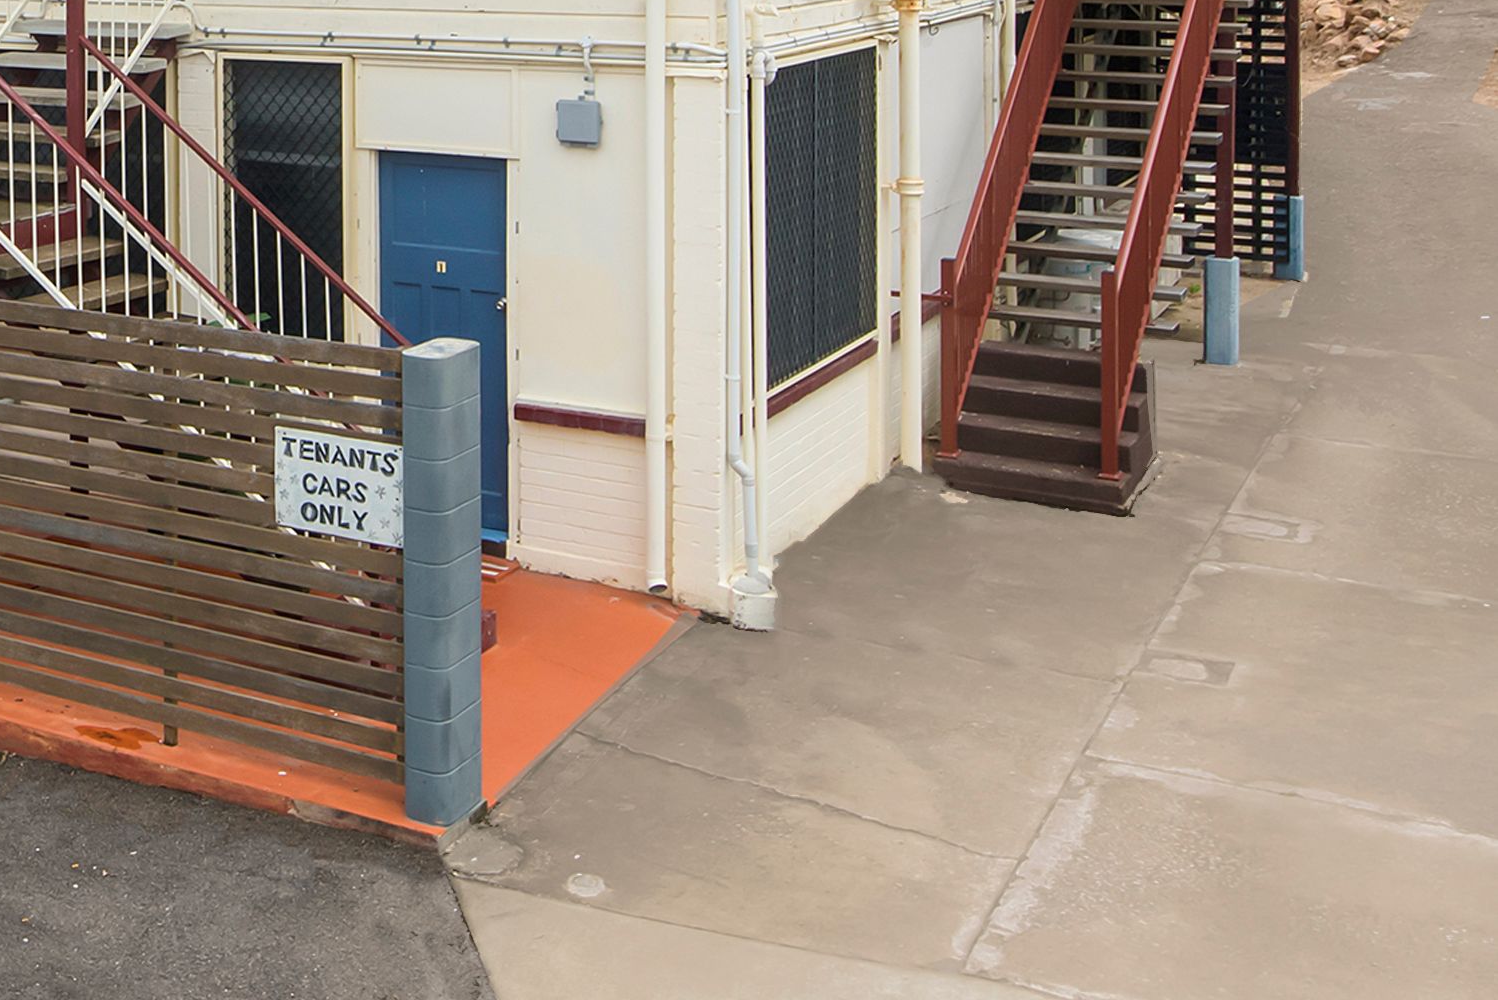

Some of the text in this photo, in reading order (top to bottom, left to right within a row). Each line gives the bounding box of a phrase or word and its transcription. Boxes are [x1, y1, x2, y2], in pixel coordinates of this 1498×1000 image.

[281, 437, 399, 477] TENANTS
[302, 472, 368, 504] CARS
[300, 502, 369, 531] ONLY
